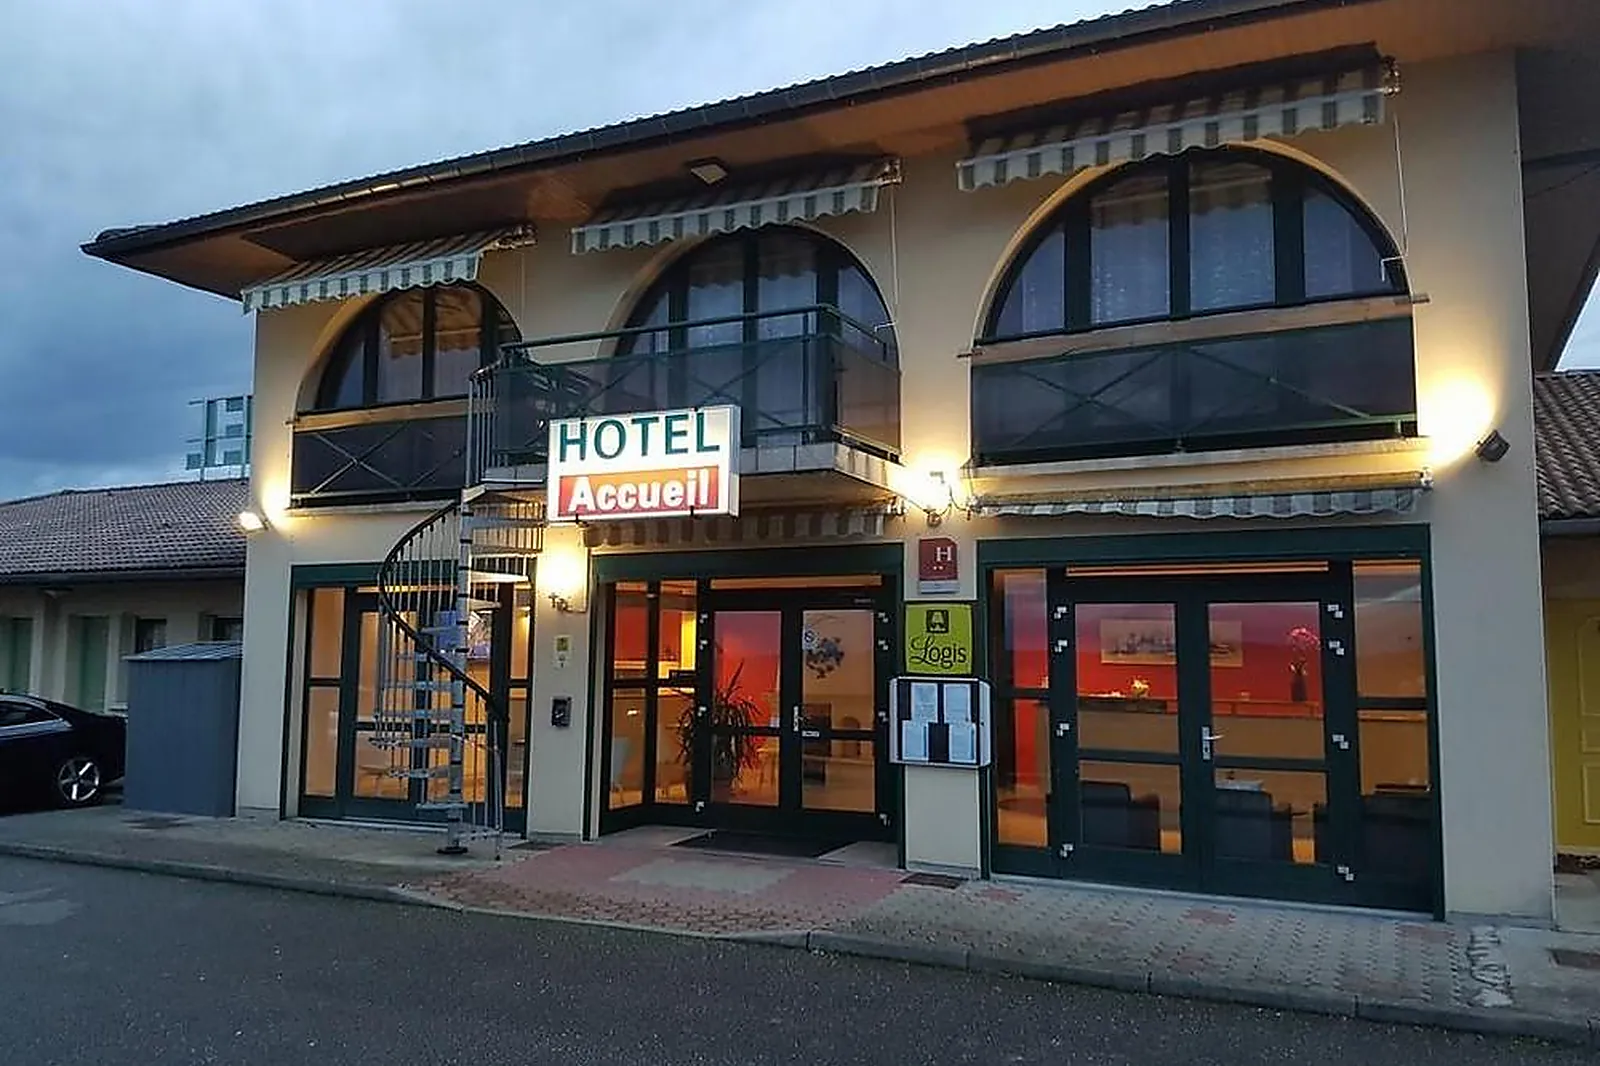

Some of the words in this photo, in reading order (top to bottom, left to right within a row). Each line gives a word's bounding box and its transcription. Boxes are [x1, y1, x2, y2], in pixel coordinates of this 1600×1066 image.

[559, 412, 720, 462] HOTEL
[568, 468, 710, 512] Accueil
[936, 546, 953, 562] H
[909, 635, 967, 670] Logis
